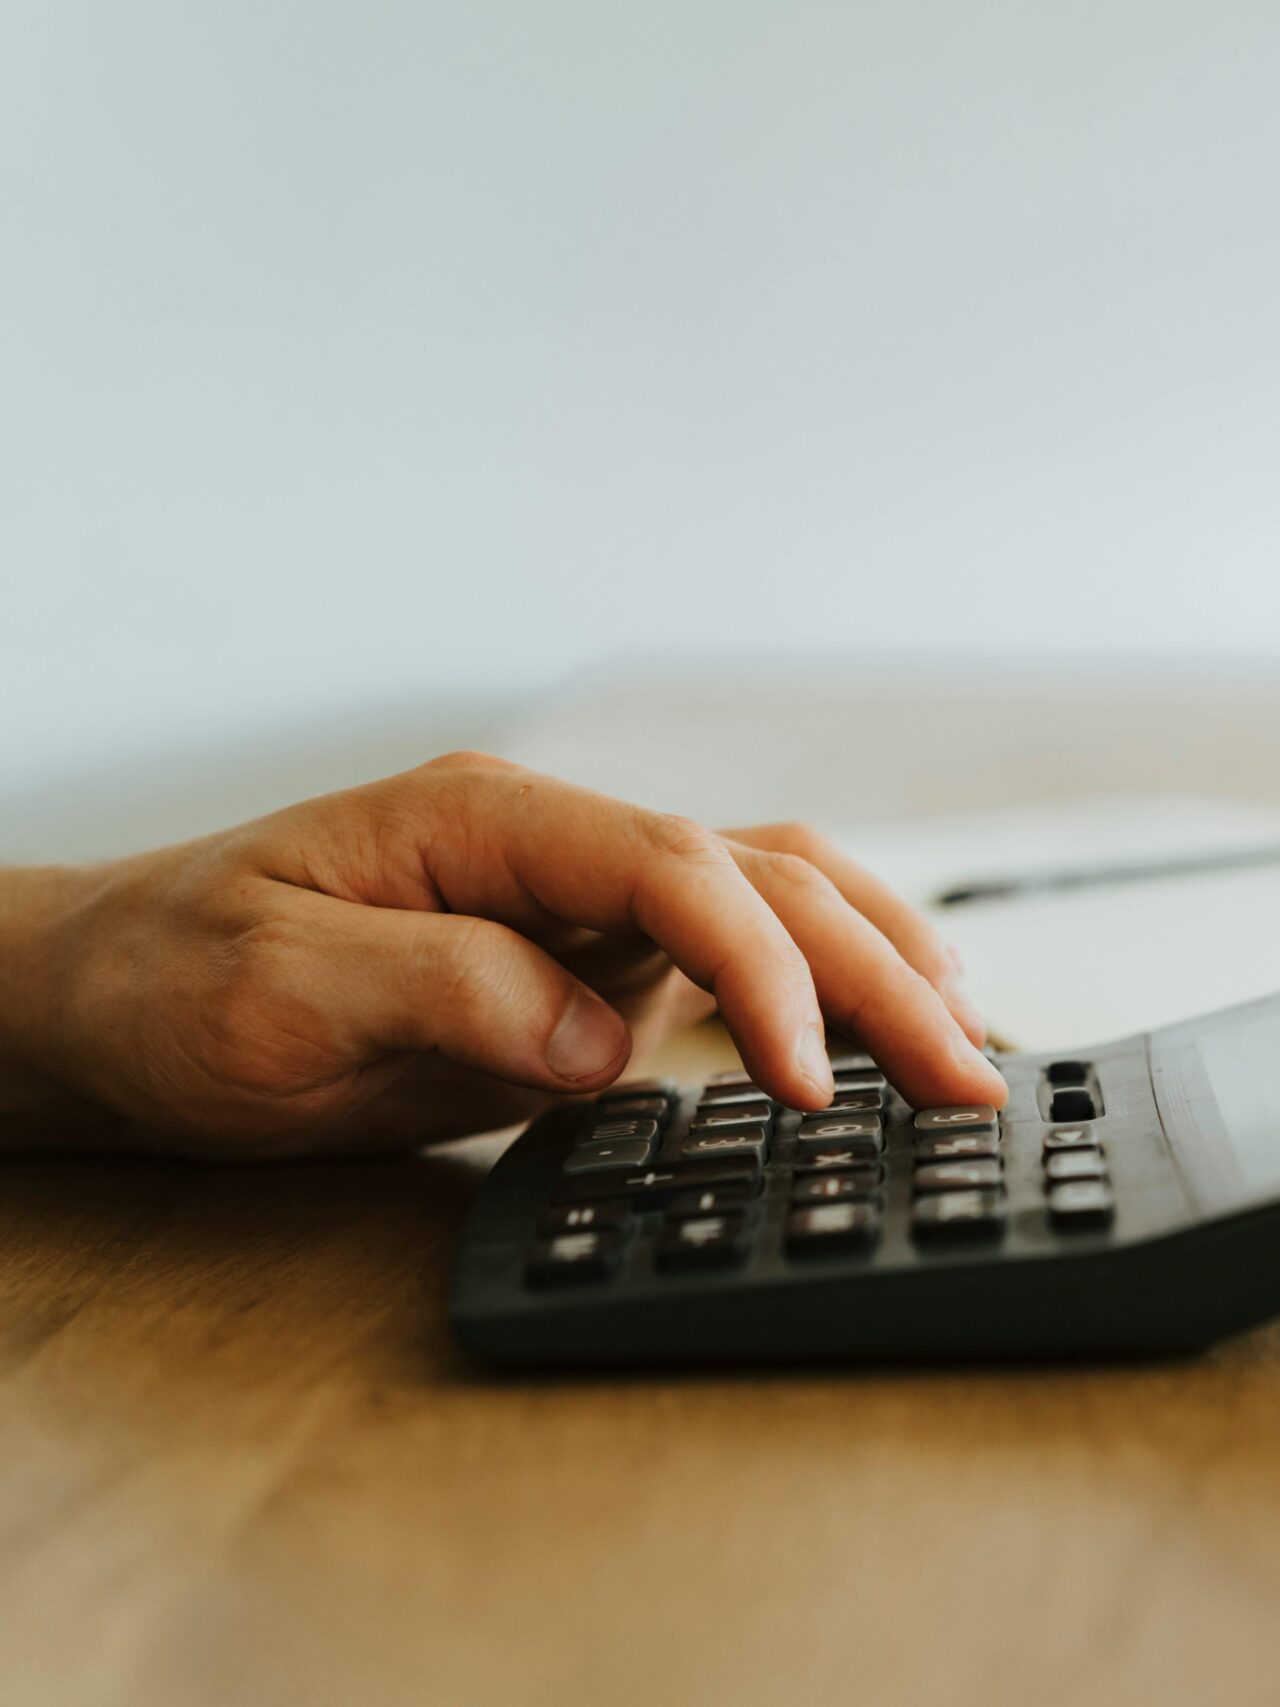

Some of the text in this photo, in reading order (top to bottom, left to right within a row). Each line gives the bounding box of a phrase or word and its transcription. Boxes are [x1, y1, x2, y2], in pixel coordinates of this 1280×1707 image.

[932, 1112, 980, 1122] 9
[816, 1124, 863, 1135] 6
[699, 1136, 747, 1148] 3
